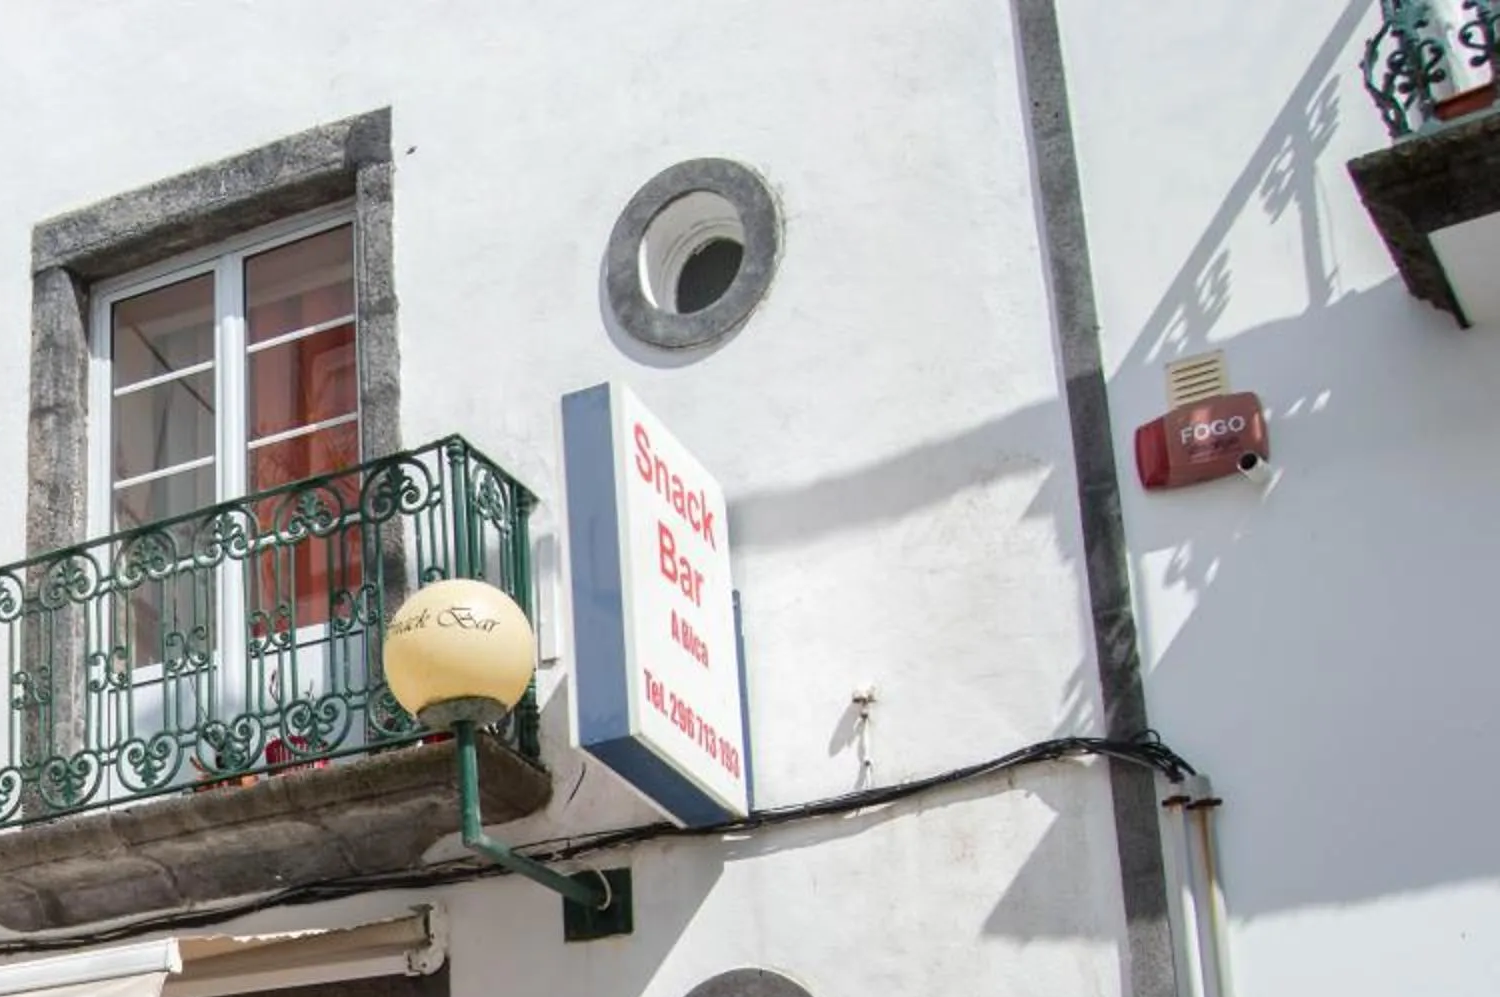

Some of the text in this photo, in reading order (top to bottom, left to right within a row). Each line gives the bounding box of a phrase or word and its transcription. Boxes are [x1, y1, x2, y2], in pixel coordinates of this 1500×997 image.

[1180, 415, 1246, 444] FOGO
[634, 422, 716, 552] Snack
[658, 519, 704, 608] Bar
[437, 606, 500, 632] Bar
